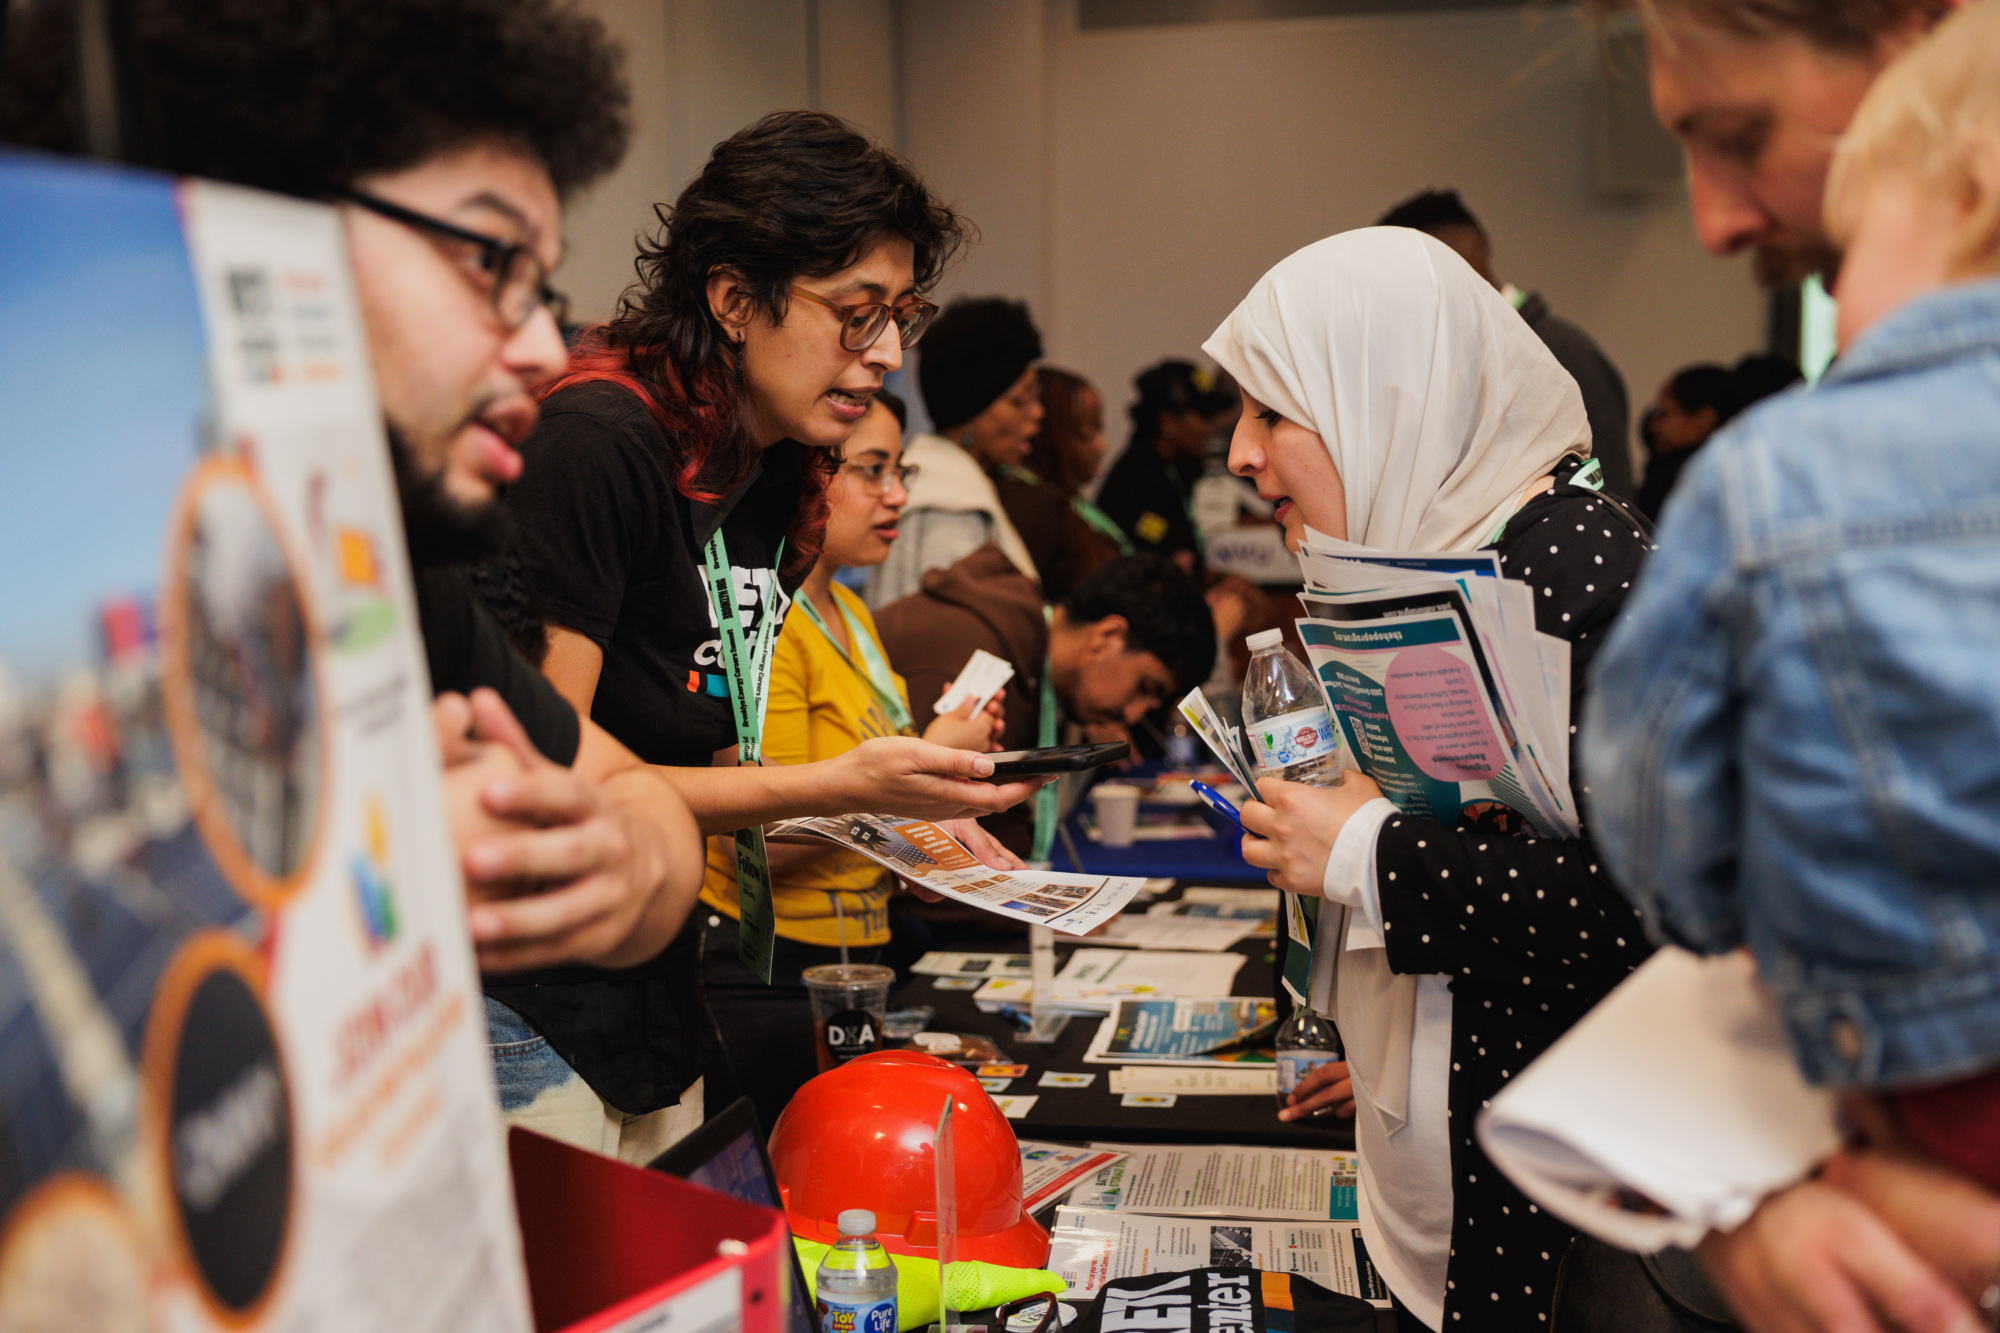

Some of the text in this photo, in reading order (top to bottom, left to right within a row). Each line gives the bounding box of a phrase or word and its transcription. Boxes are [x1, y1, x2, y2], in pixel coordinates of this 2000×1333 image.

[727, 628, 749, 728] Brooklyn Energy Careers Summit
[1197, 1272, 1252, 1333] enter
[832, 1310, 857, 1324] TOY
[871, 1307, 893, 1321] Pure
[874, 1319, 891, 1332] Life
